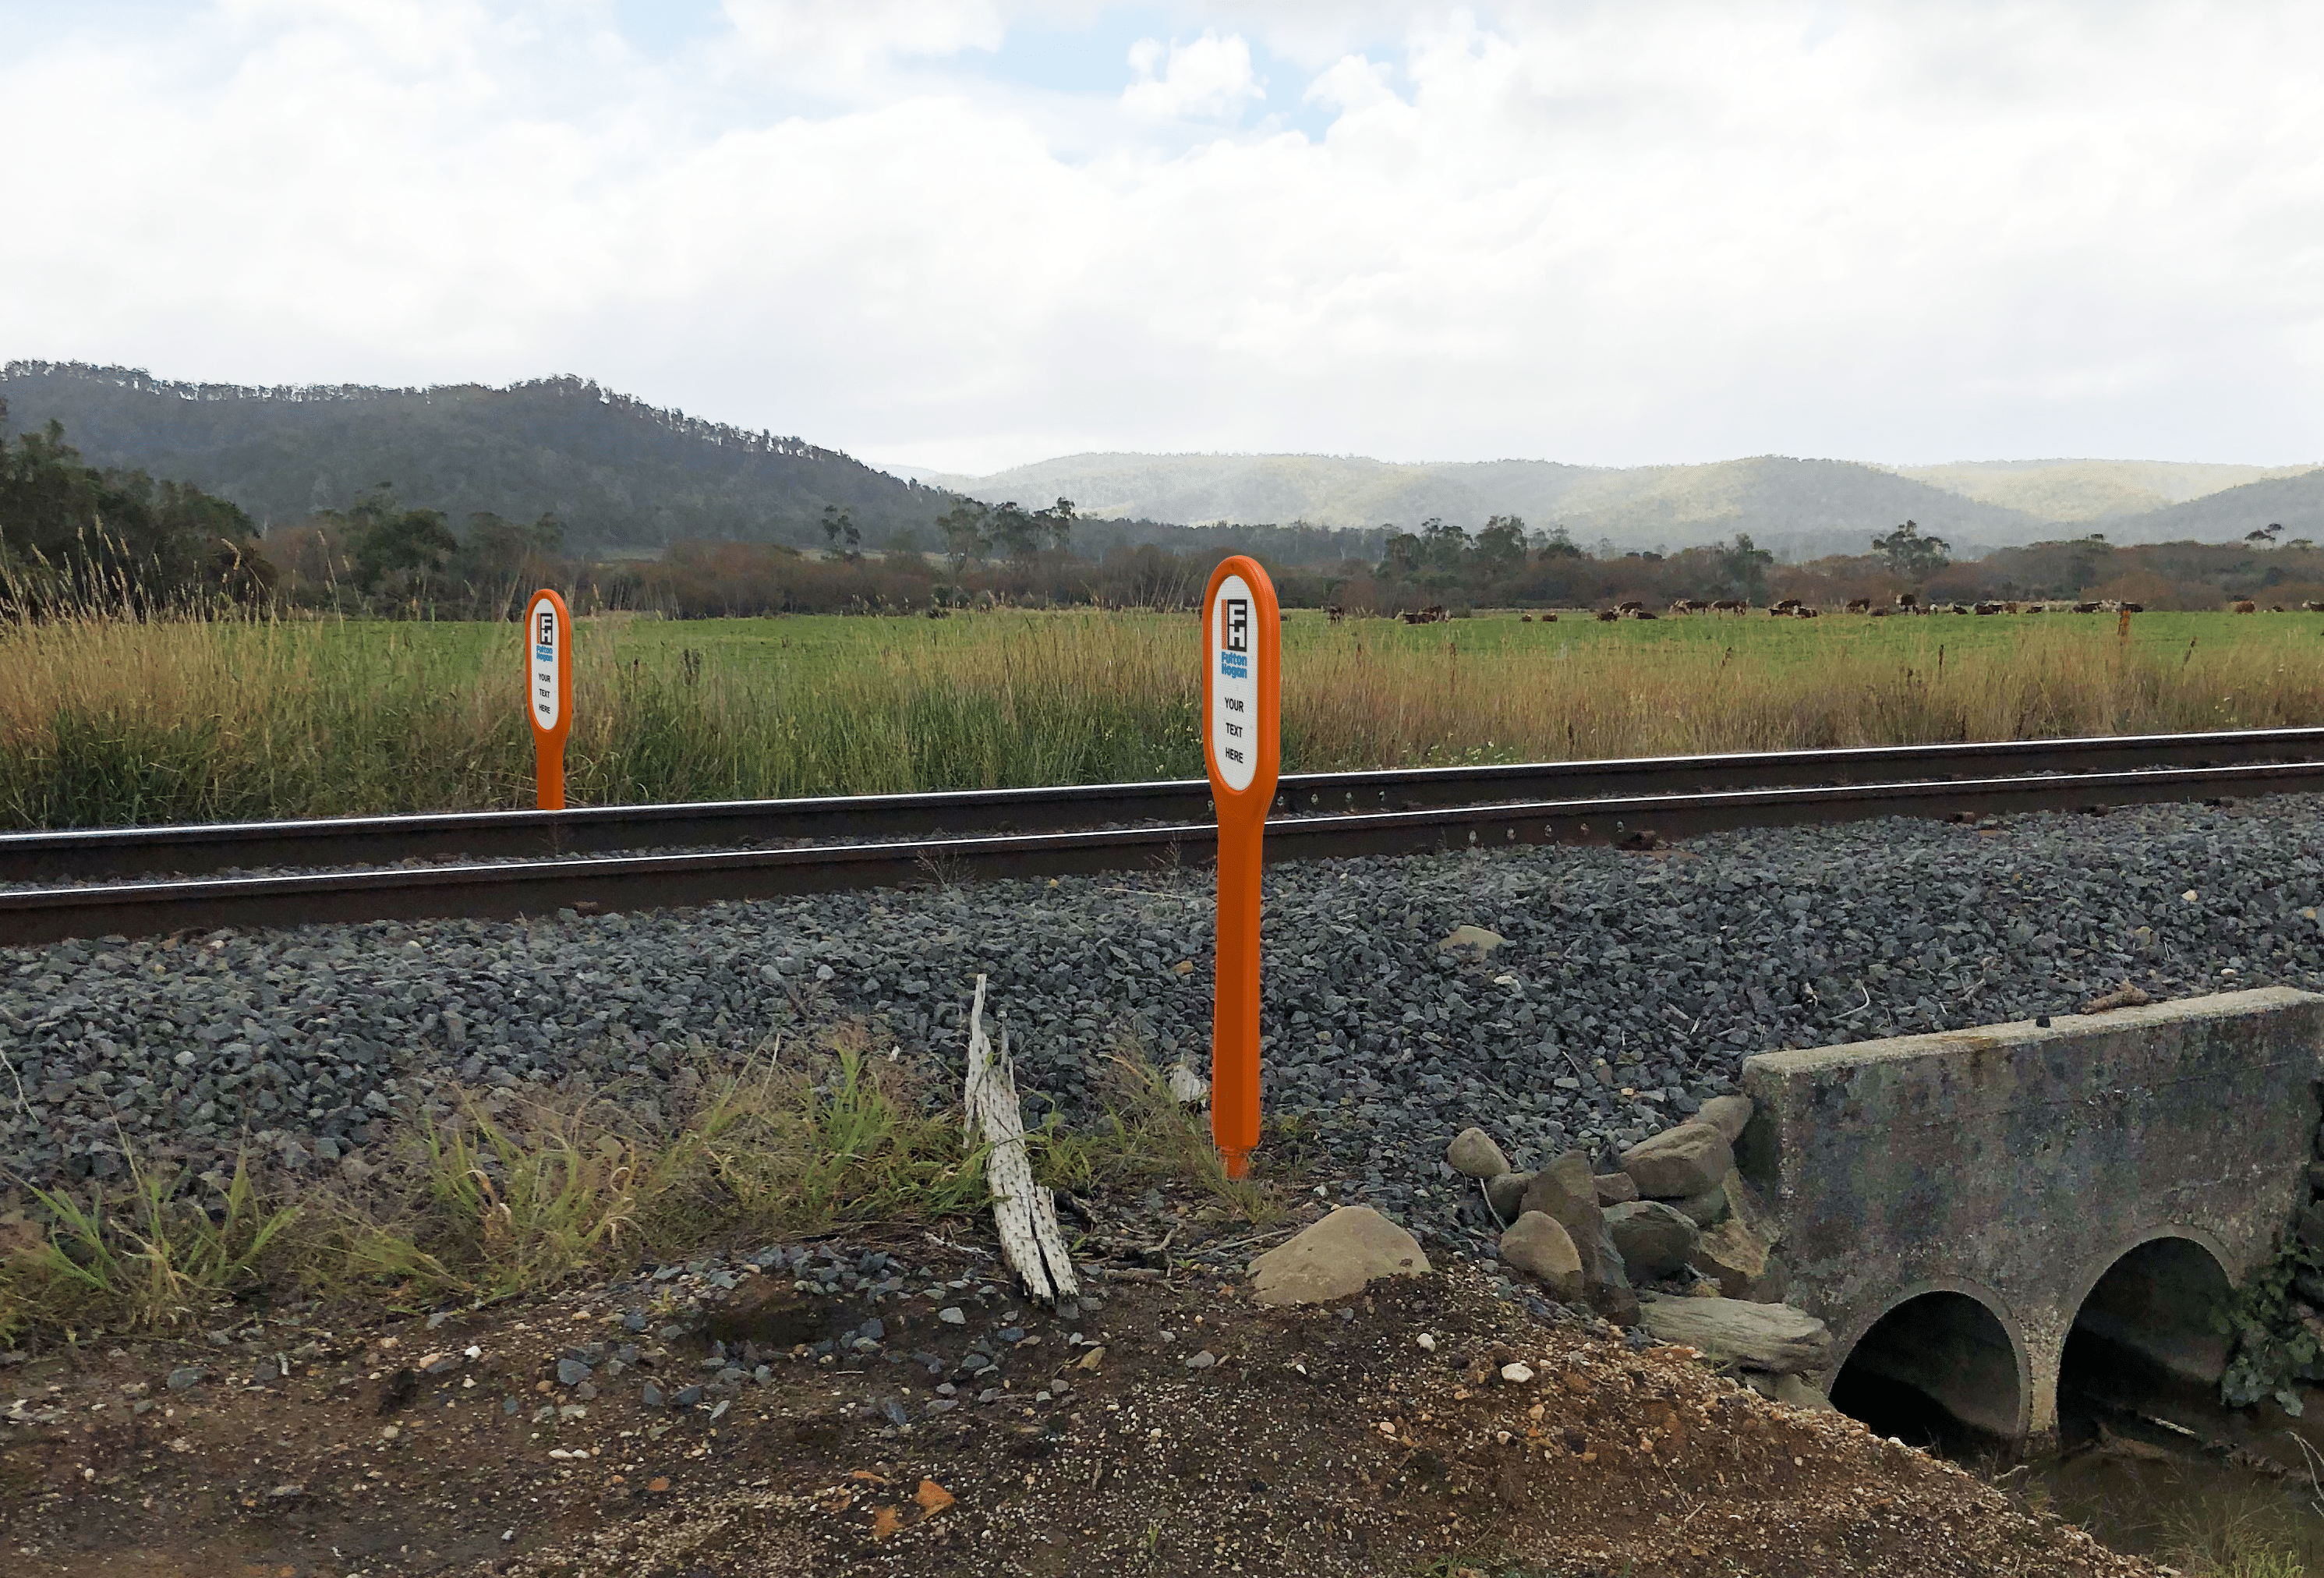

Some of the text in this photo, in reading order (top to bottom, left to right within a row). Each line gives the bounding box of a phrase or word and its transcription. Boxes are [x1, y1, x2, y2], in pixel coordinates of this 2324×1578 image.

[1221, 652, 1247, 667] Fulton
[538, 673, 551, 683] YOUR
[1221, 663, 1247, 678] Hogan
[539, 688, 550, 699] TEXT
[539, 704, 550, 714] HERE
[1224, 697, 1244, 713] YOUR
[1226, 722, 1243, 738] TEXT
[1225, 747, 1243, 764] HERE
